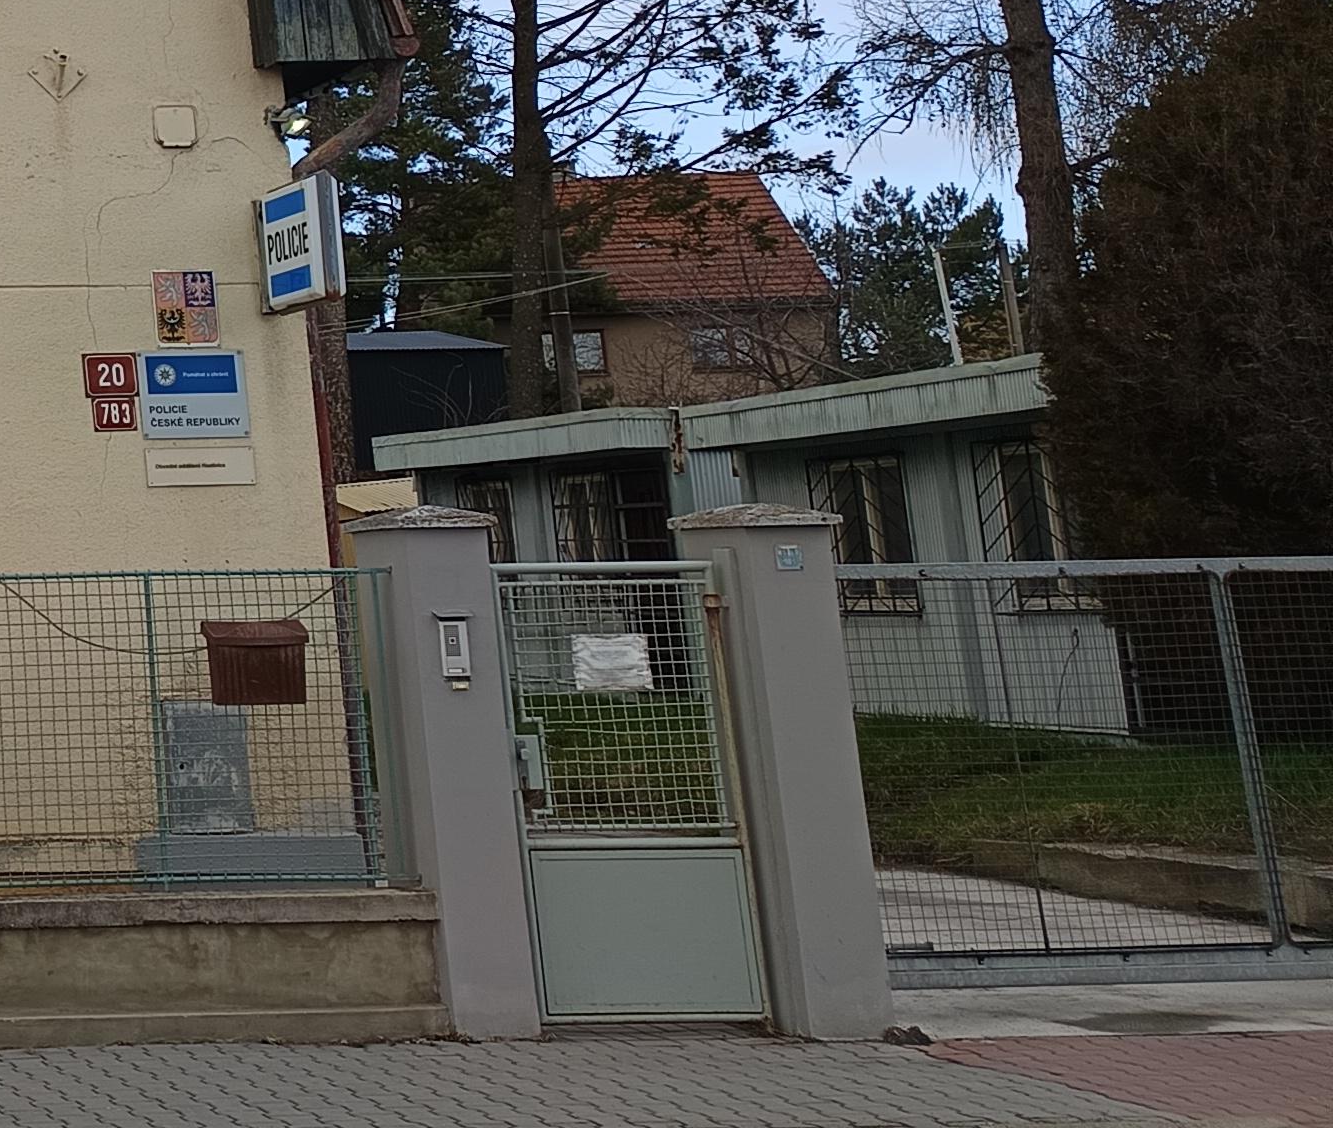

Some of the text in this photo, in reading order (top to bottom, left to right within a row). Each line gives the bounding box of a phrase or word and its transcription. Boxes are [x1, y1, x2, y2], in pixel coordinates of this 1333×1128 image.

[267, 221, 309, 265] POLICIE
[97, 363, 125, 387] 20
[100, 402, 131, 425] 783
[149, 405, 189, 414] POLICIE
[150, 416, 241, 428] ČESKÉ REPUBLIKY
